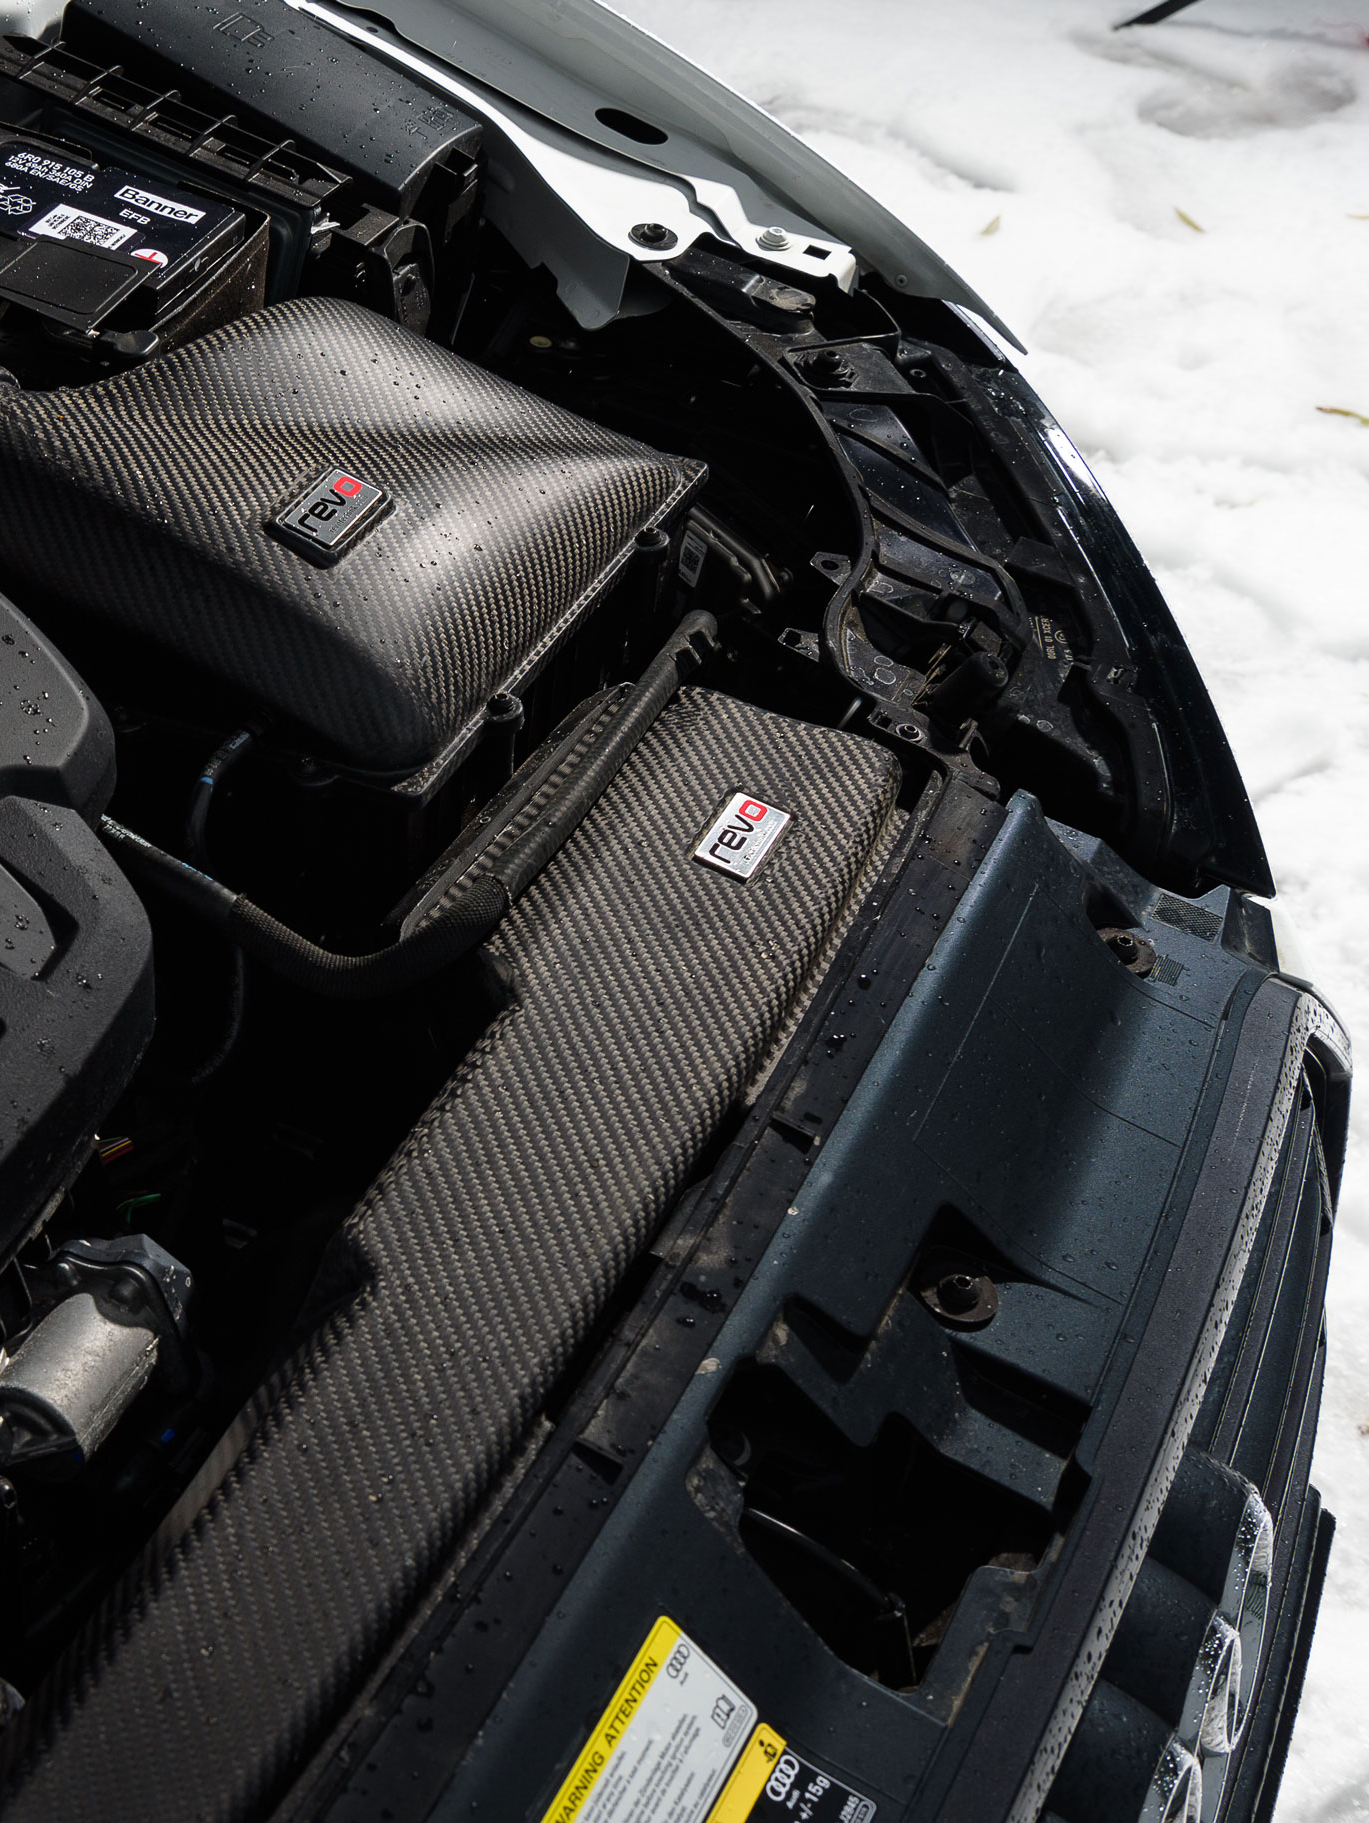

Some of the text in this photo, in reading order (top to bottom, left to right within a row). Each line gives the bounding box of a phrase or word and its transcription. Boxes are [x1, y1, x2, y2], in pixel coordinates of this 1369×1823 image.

[5, 161, 84, 192] 680A EN/SAE/GS
[9, 156, 27, 164] 12V
[49, 170, 73, 181] 360A
[73, 178, 93, 188] DIN
[18, 152, 95, 182] 6R0 915 105 B
[119, 188, 198, 220] Banner
[119, 208, 151, 224] EFB
[298, 476, 362, 533] revo
[709, 800, 767, 864] revo
[604, 1656, 658, 1748] ATTENTION
